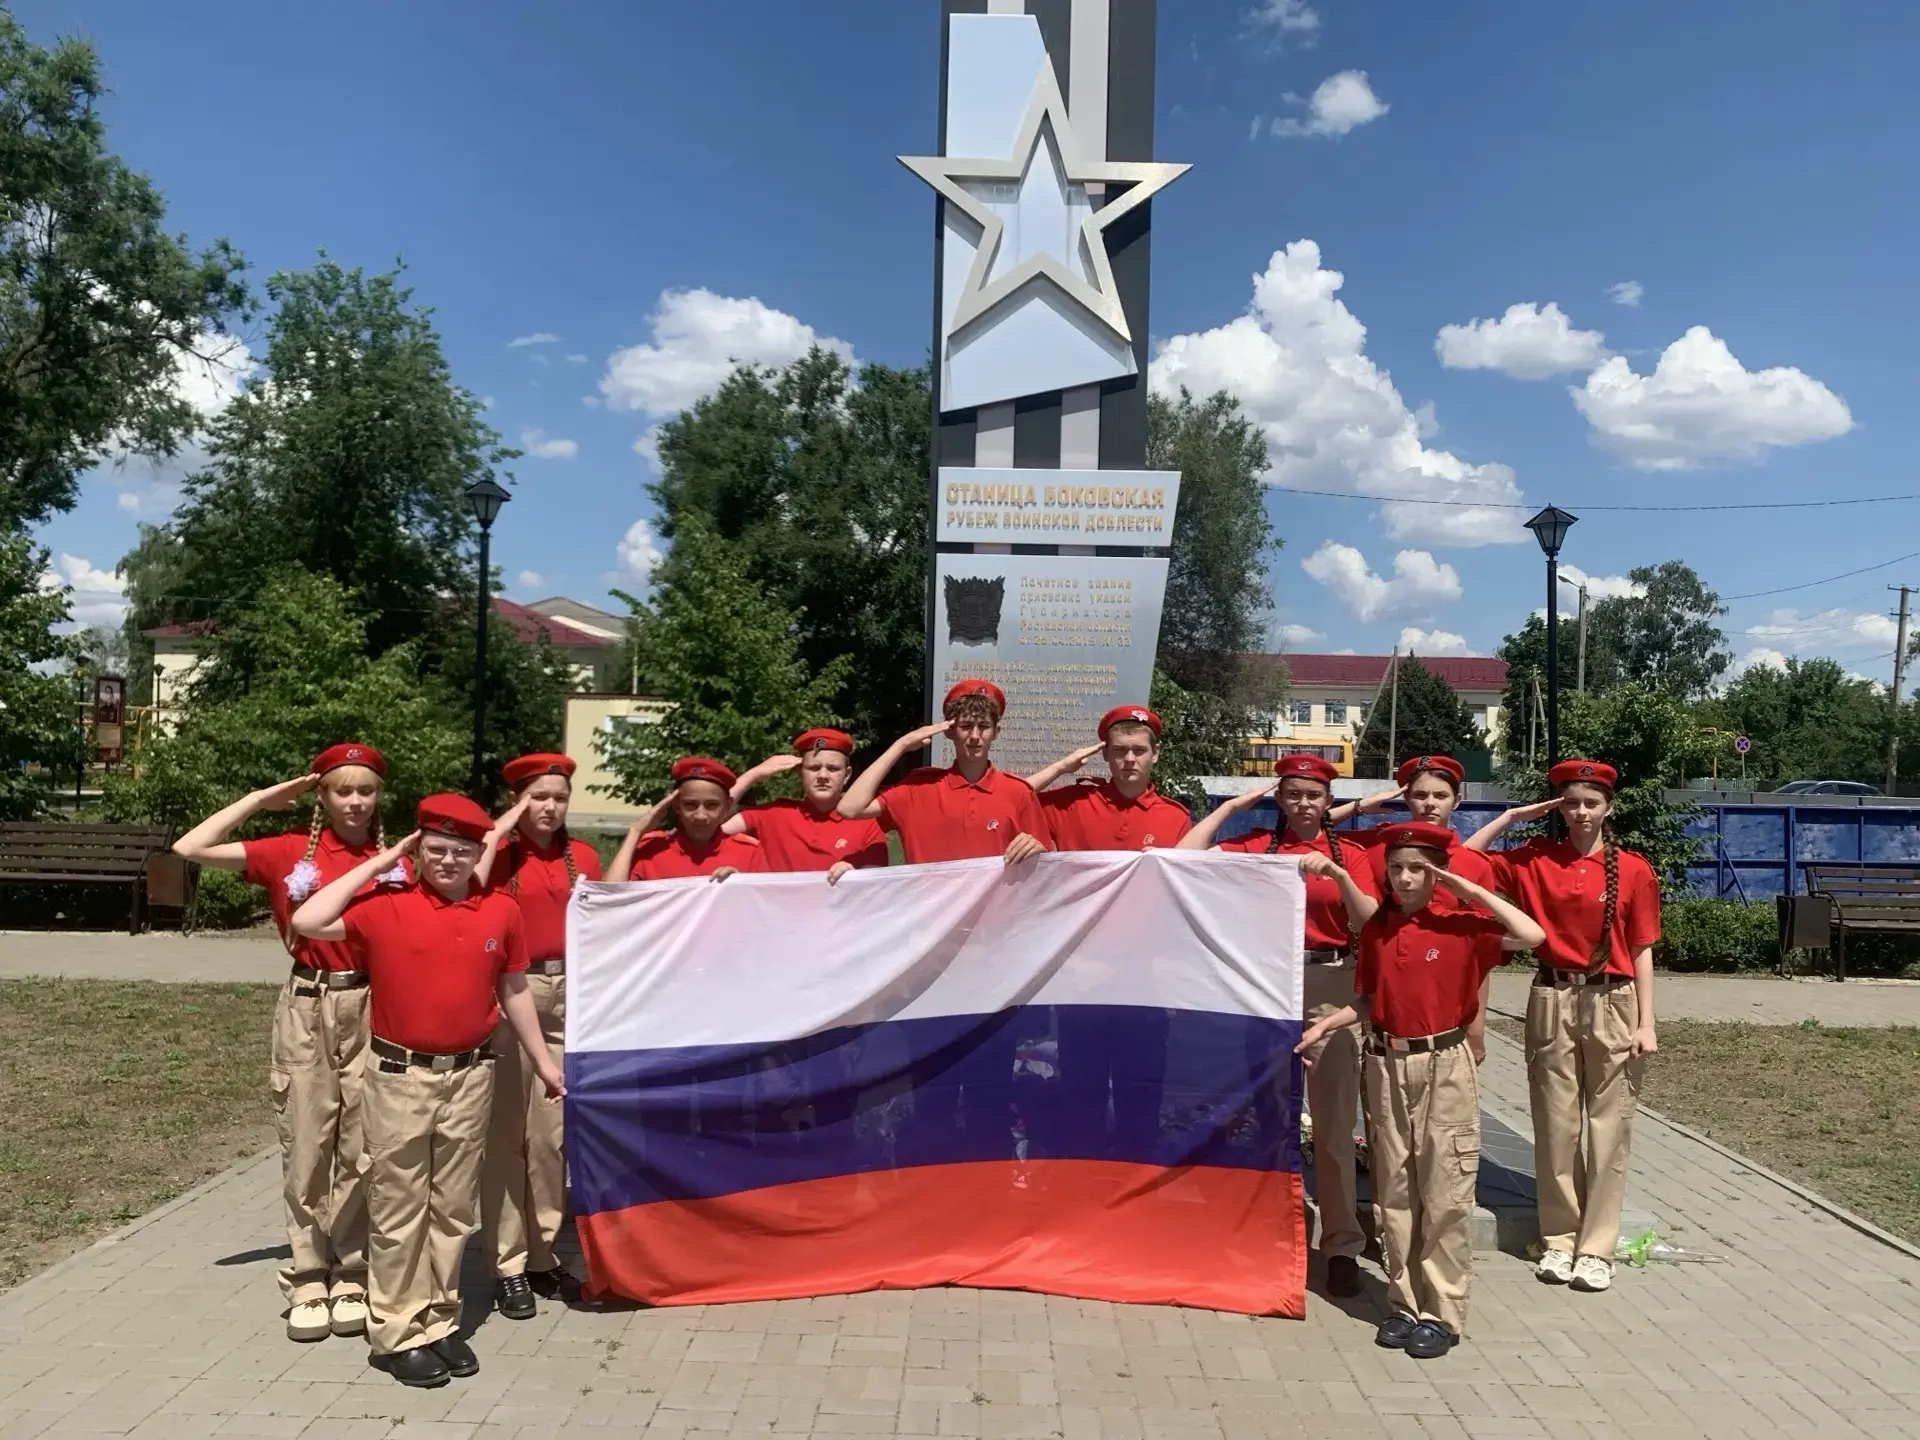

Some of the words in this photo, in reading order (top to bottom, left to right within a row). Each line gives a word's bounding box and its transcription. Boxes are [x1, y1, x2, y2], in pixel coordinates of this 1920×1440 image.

[945, 483, 1038, 509] СТАНИЦА
[1044, 485, 1165, 509] БОКОВСКАЯ
[946, 512, 998, 528] РУБЕЖ
[1003, 512, 1080, 530] ВОИНСКОЙ
[1085, 515, 1163, 533] ДОБЛЕСТИ
[1020, 605, 1132, 619] Губернатора
[1019, 620, 1083, 632] Ростовской
[1087, 621, 1132, 633] области
